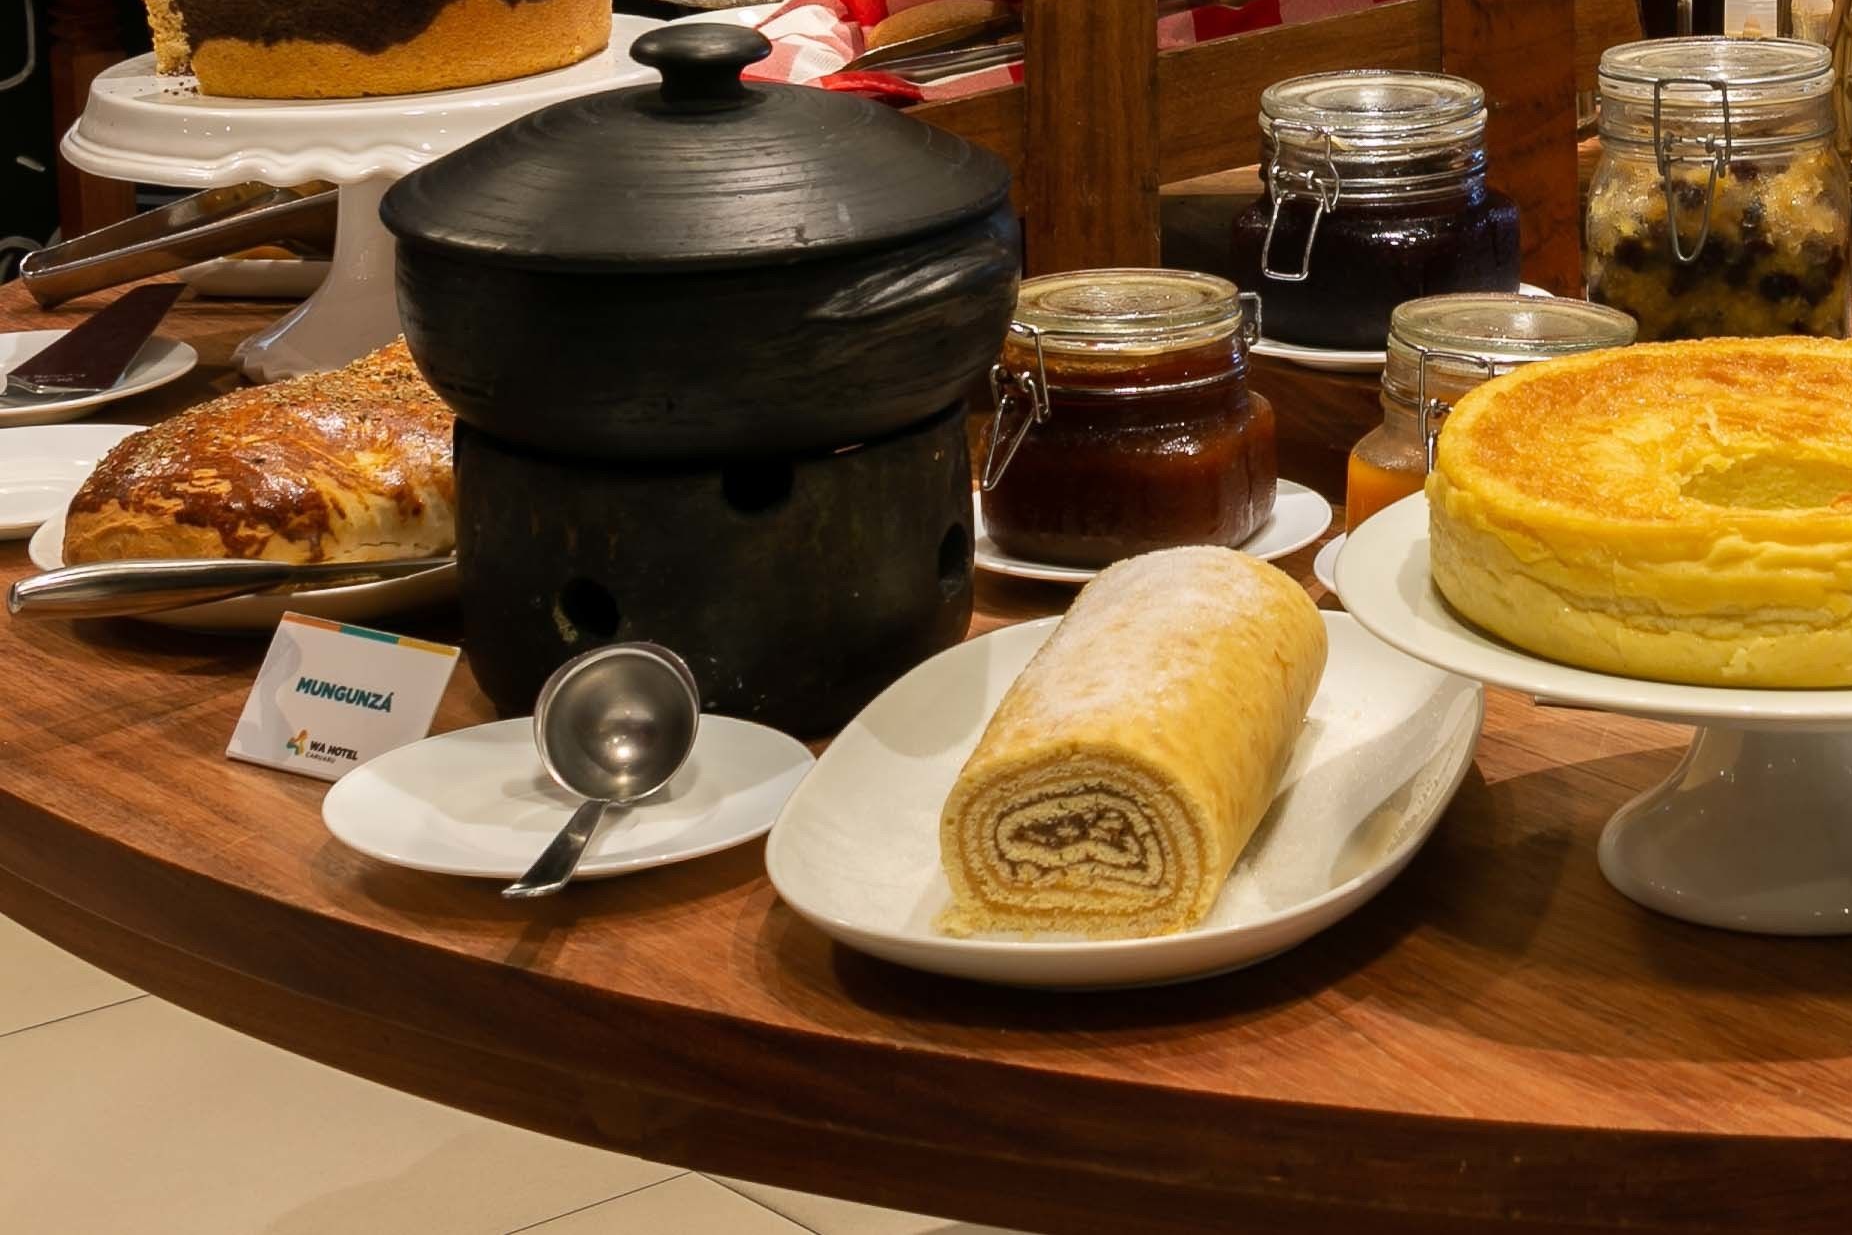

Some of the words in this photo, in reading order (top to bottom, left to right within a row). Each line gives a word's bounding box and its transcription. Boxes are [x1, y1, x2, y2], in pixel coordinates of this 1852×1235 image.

[296, 676, 395, 713] MUNGUNZÁ
[309, 740, 326, 753] WA
[327, 745, 359, 761] HOTEL
